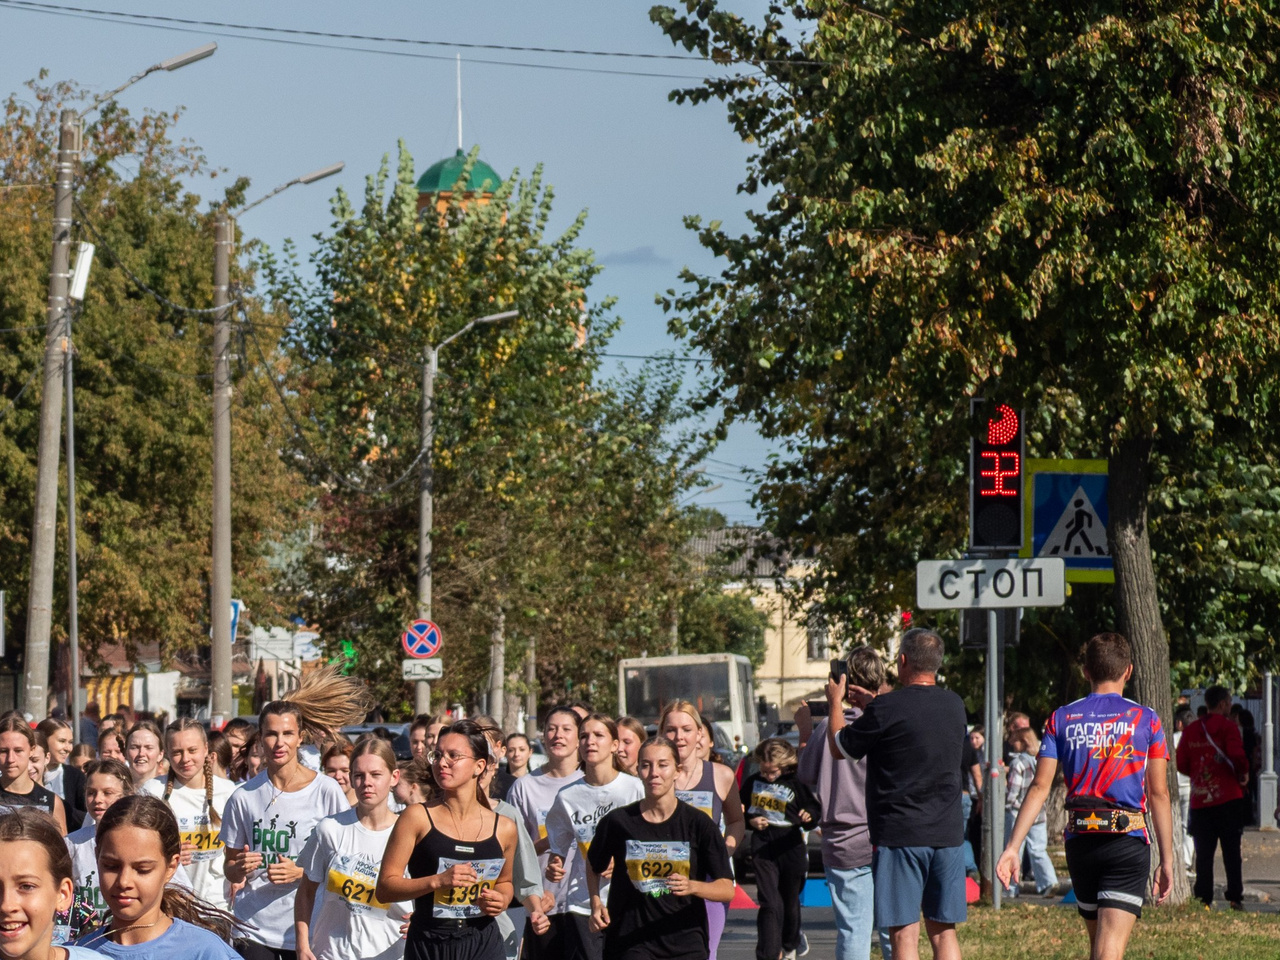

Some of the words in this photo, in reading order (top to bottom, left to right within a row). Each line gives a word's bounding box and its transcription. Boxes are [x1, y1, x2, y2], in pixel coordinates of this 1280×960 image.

[981, 452, 1019, 496] 32
[939, 568, 1043, 600] СТОП
[1066, 722, 1135, 739] ГАГАРИН
[1093, 743, 1135, 759] 2022
[252, 828, 289, 852] PRO
[641, 862, 673, 878] 622
[342, 879, 375, 903] 621
